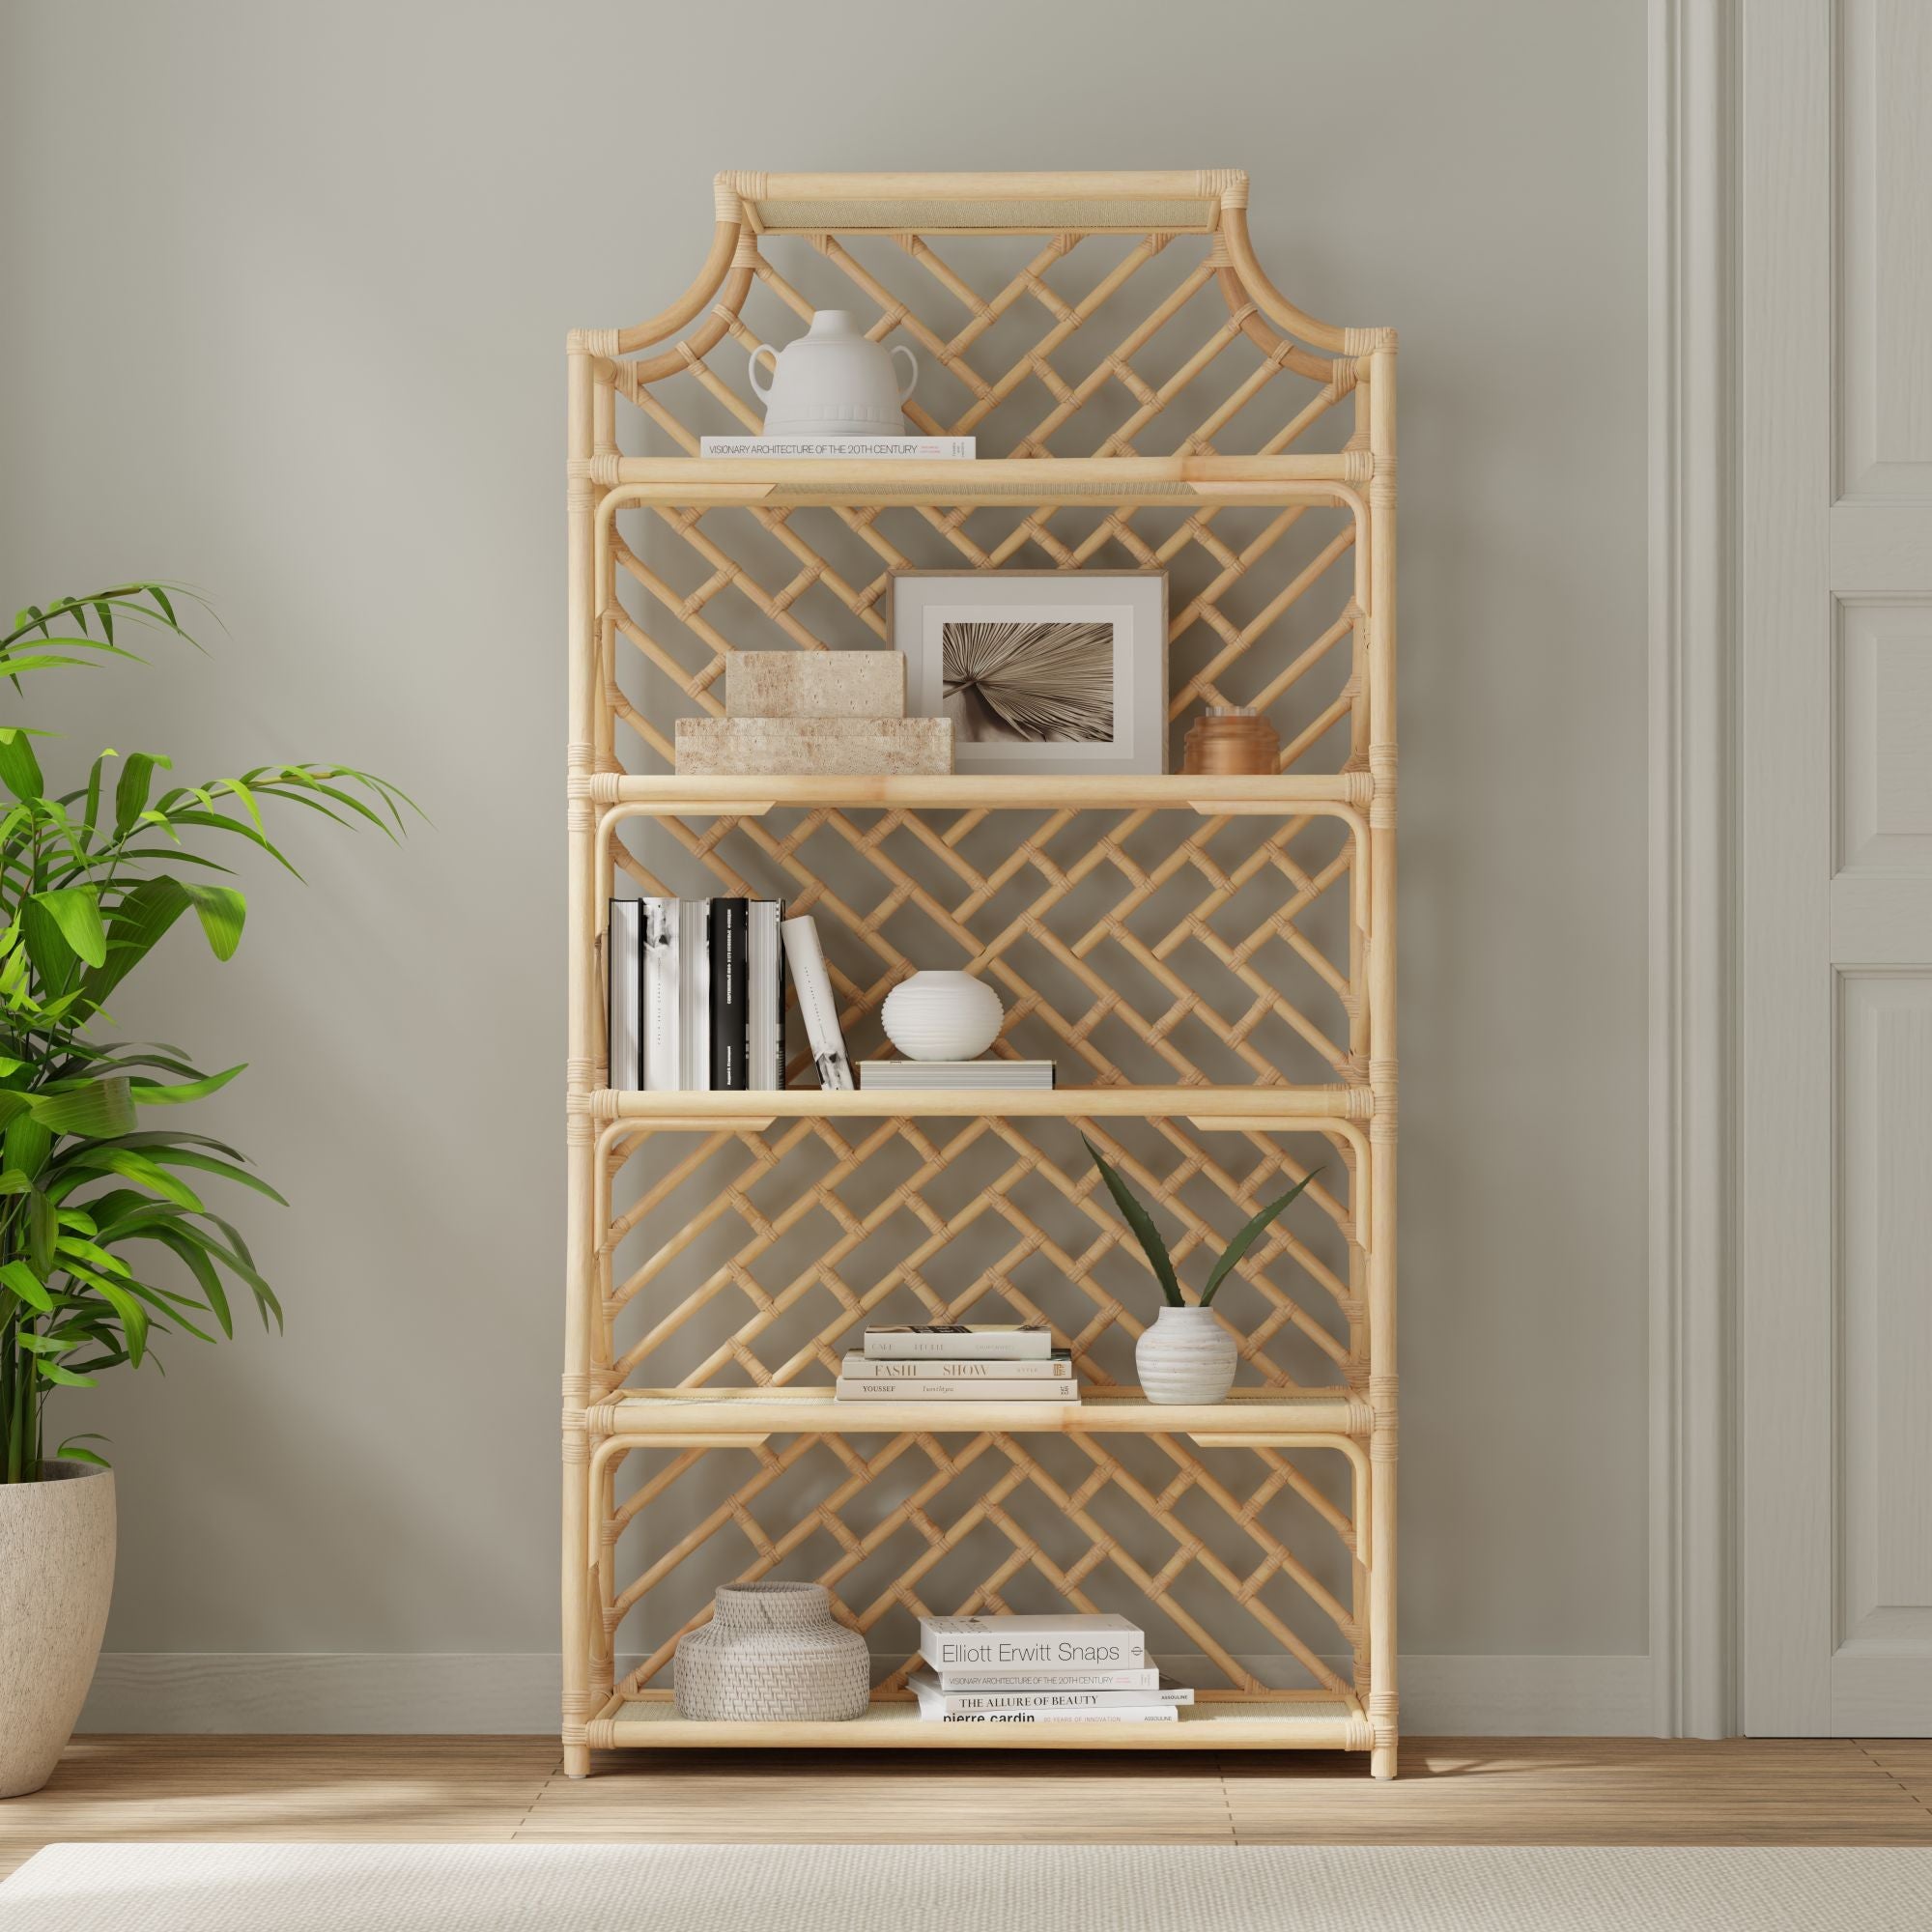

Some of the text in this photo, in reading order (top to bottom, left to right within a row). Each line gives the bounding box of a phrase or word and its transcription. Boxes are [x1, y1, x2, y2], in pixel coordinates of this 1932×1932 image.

[710, 444, 918, 454] VISIONARY ARCHITECTURE OF THE 20TH CENTURY
[943, 1364, 989, 1377] SHOW
[942, 1641, 1121, 1664] Elliott Erwitt Snaps
[1033, 1676, 1043, 1685] OF
[1043, 1676, 1058, 1685] THE
[1058, 1676, 1078, 1685] 20TH
[1078, 1676, 1114, 1685] CENTURY
[959, 1695, 1098, 1708] THE ALLURE OF BEAUTY
[990, 1713, 1035, 1722] cardin
